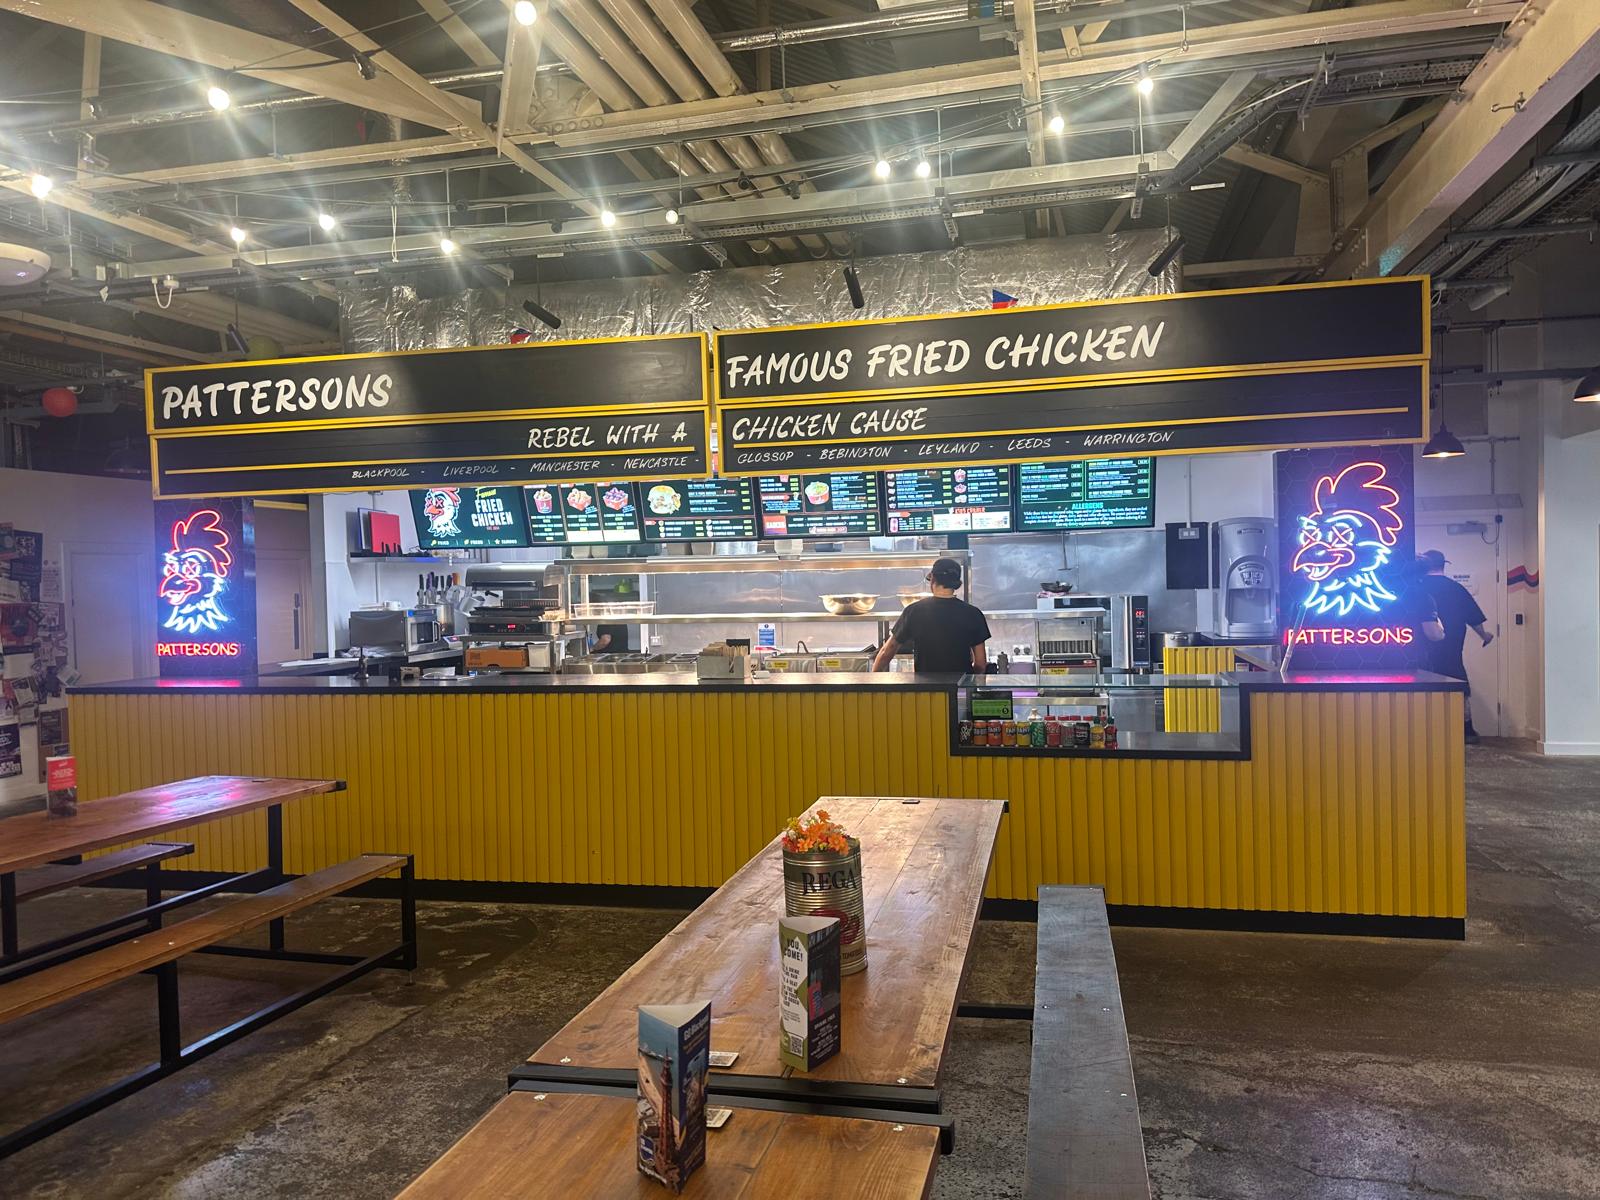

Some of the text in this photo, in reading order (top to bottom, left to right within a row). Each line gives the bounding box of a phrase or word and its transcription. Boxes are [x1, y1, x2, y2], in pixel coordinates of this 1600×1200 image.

[726, 321, 1166, 390] FAMOUS FRIED CHICKEN
[161, 374, 394, 420] PATTERSONS
[527, 421, 688, 449] REBEL WITH A
[732, 407, 928, 441] CHICKEN CAUSE
[737, 430, 1175, 465] GLOSSOP BEBINGTON LEYLAND LEEDS WARRINGTON
[351, 456, 688, 479] BLACKPOOL LIVERPOOL MANCHESTER NEWCASTLE
[471, 511, 514, 527] CHICKEN
[474, 498, 504, 513] FRIED
[157, 642, 240, 657] PATTERSONS
